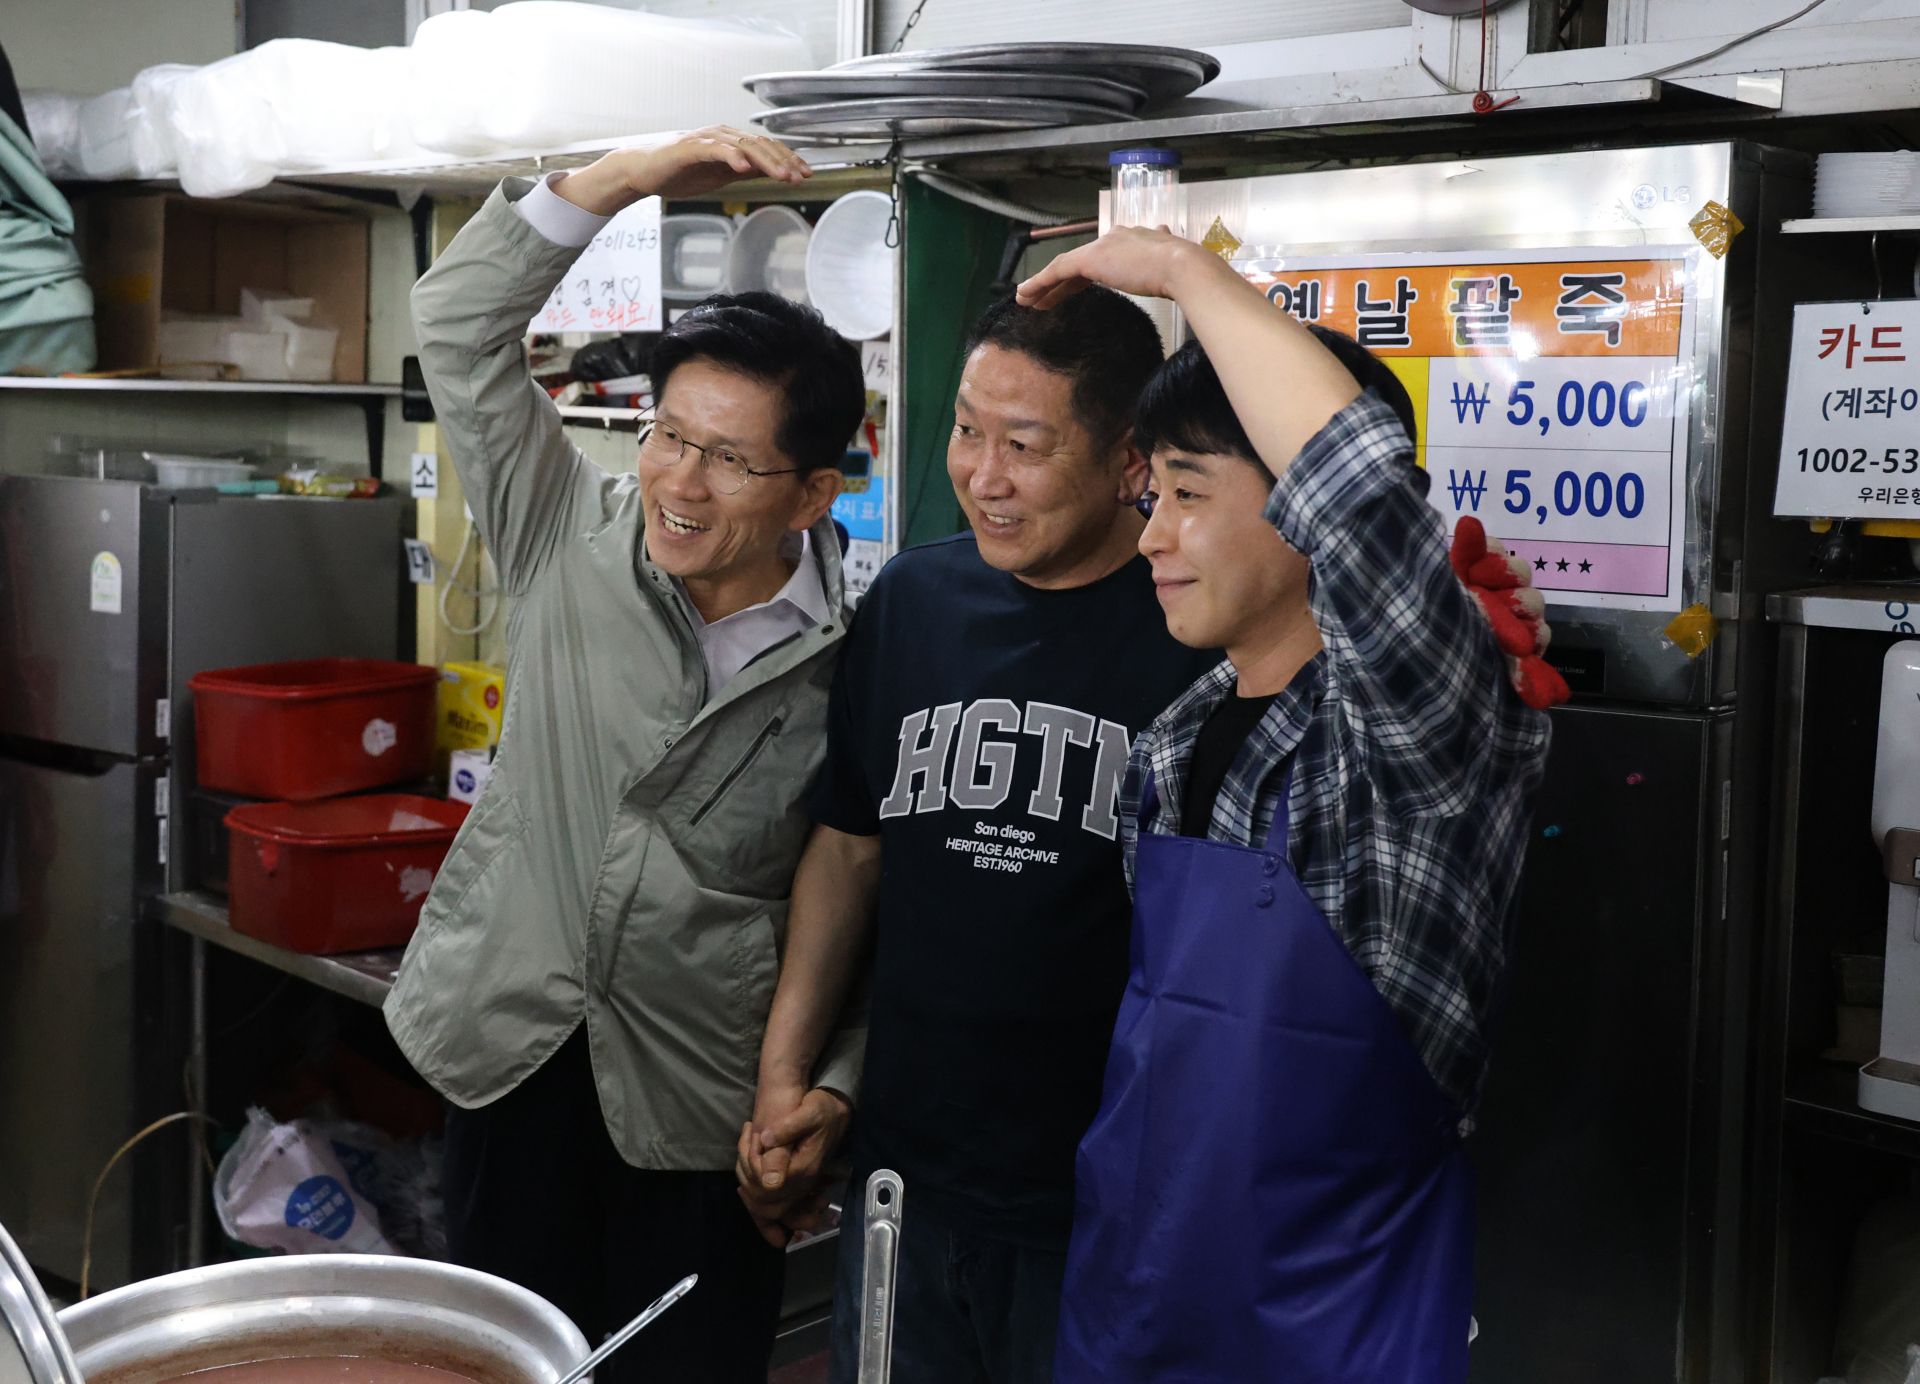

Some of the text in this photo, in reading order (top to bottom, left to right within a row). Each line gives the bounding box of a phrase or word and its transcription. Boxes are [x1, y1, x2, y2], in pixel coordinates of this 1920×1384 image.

[1662, 184, 1691, 203] LG
[1818, 324, 1906, 369] 카드
[1506, 380, 1648, 437] 5,000
[415, 459, 435, 488] 소
[1797, 447, 1919, 474] 1002-53
[1503, 469, 1645, 525] 5,000
[974, 820, 1036, 844] San diego
[945, 837, 1060, 865] HERITAGE ARCHIVE
[973, 855, 1023, 874] EST.1960
